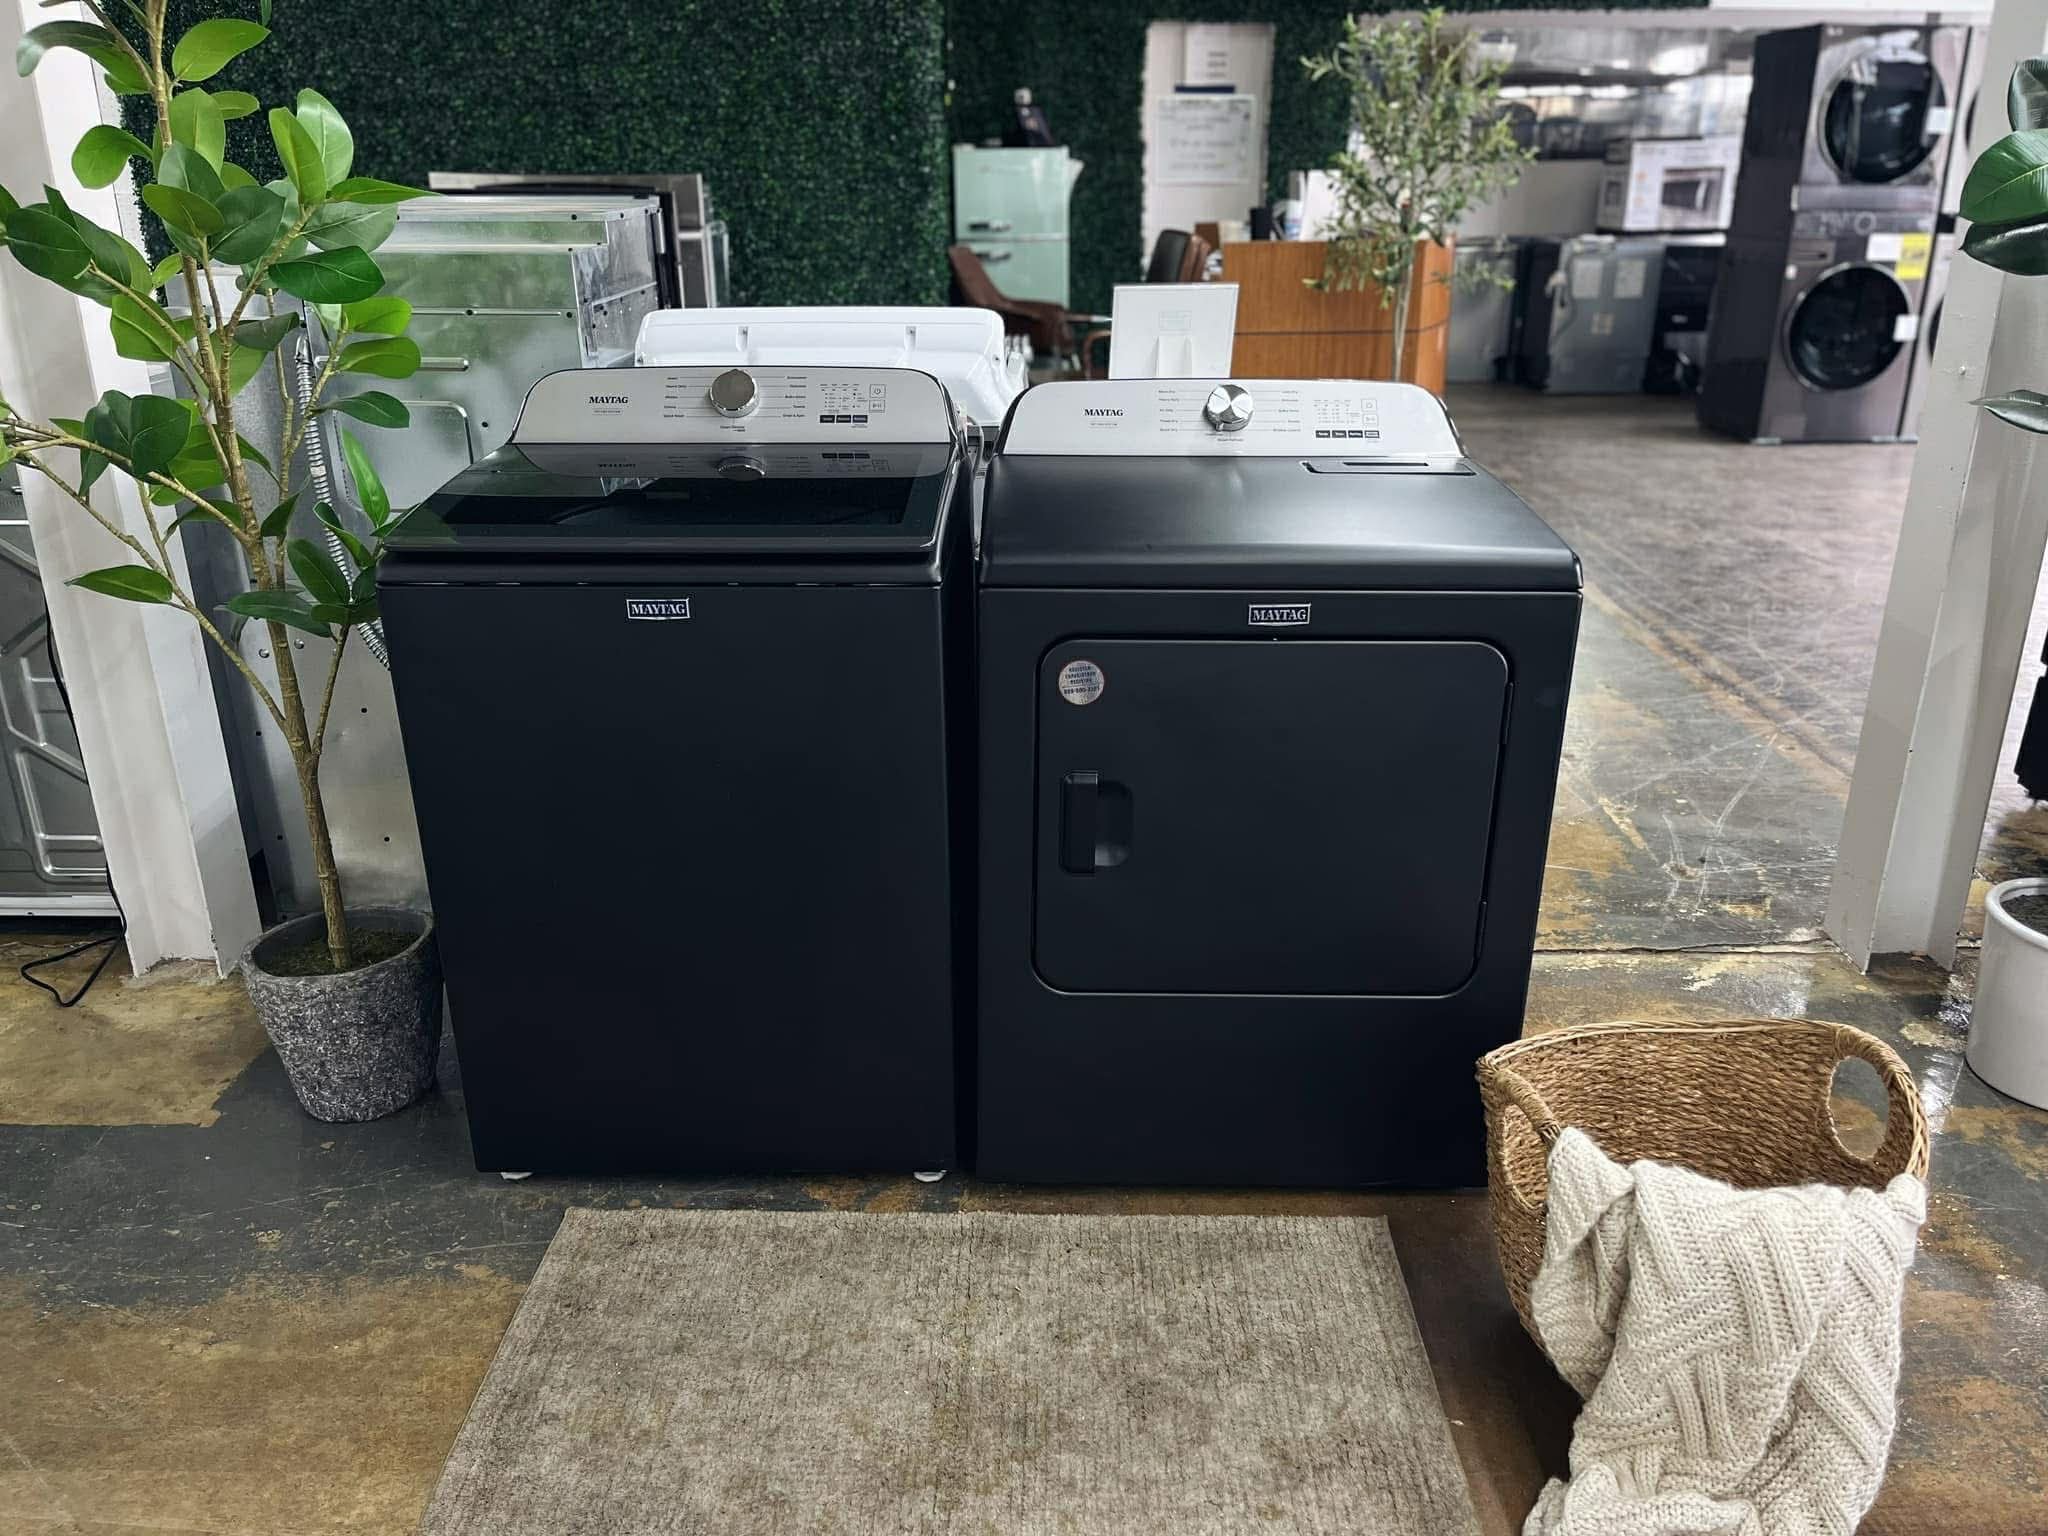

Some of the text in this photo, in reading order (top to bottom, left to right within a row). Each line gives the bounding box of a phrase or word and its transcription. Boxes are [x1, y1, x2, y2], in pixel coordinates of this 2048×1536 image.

[589, 396, 629, 404] MAYTAG
[1084, 409, 1124, 417] MAYTAG
[631, 603, 685, 615] MAYTAG
[1253, 609, 1307, 621] MAYTAG
